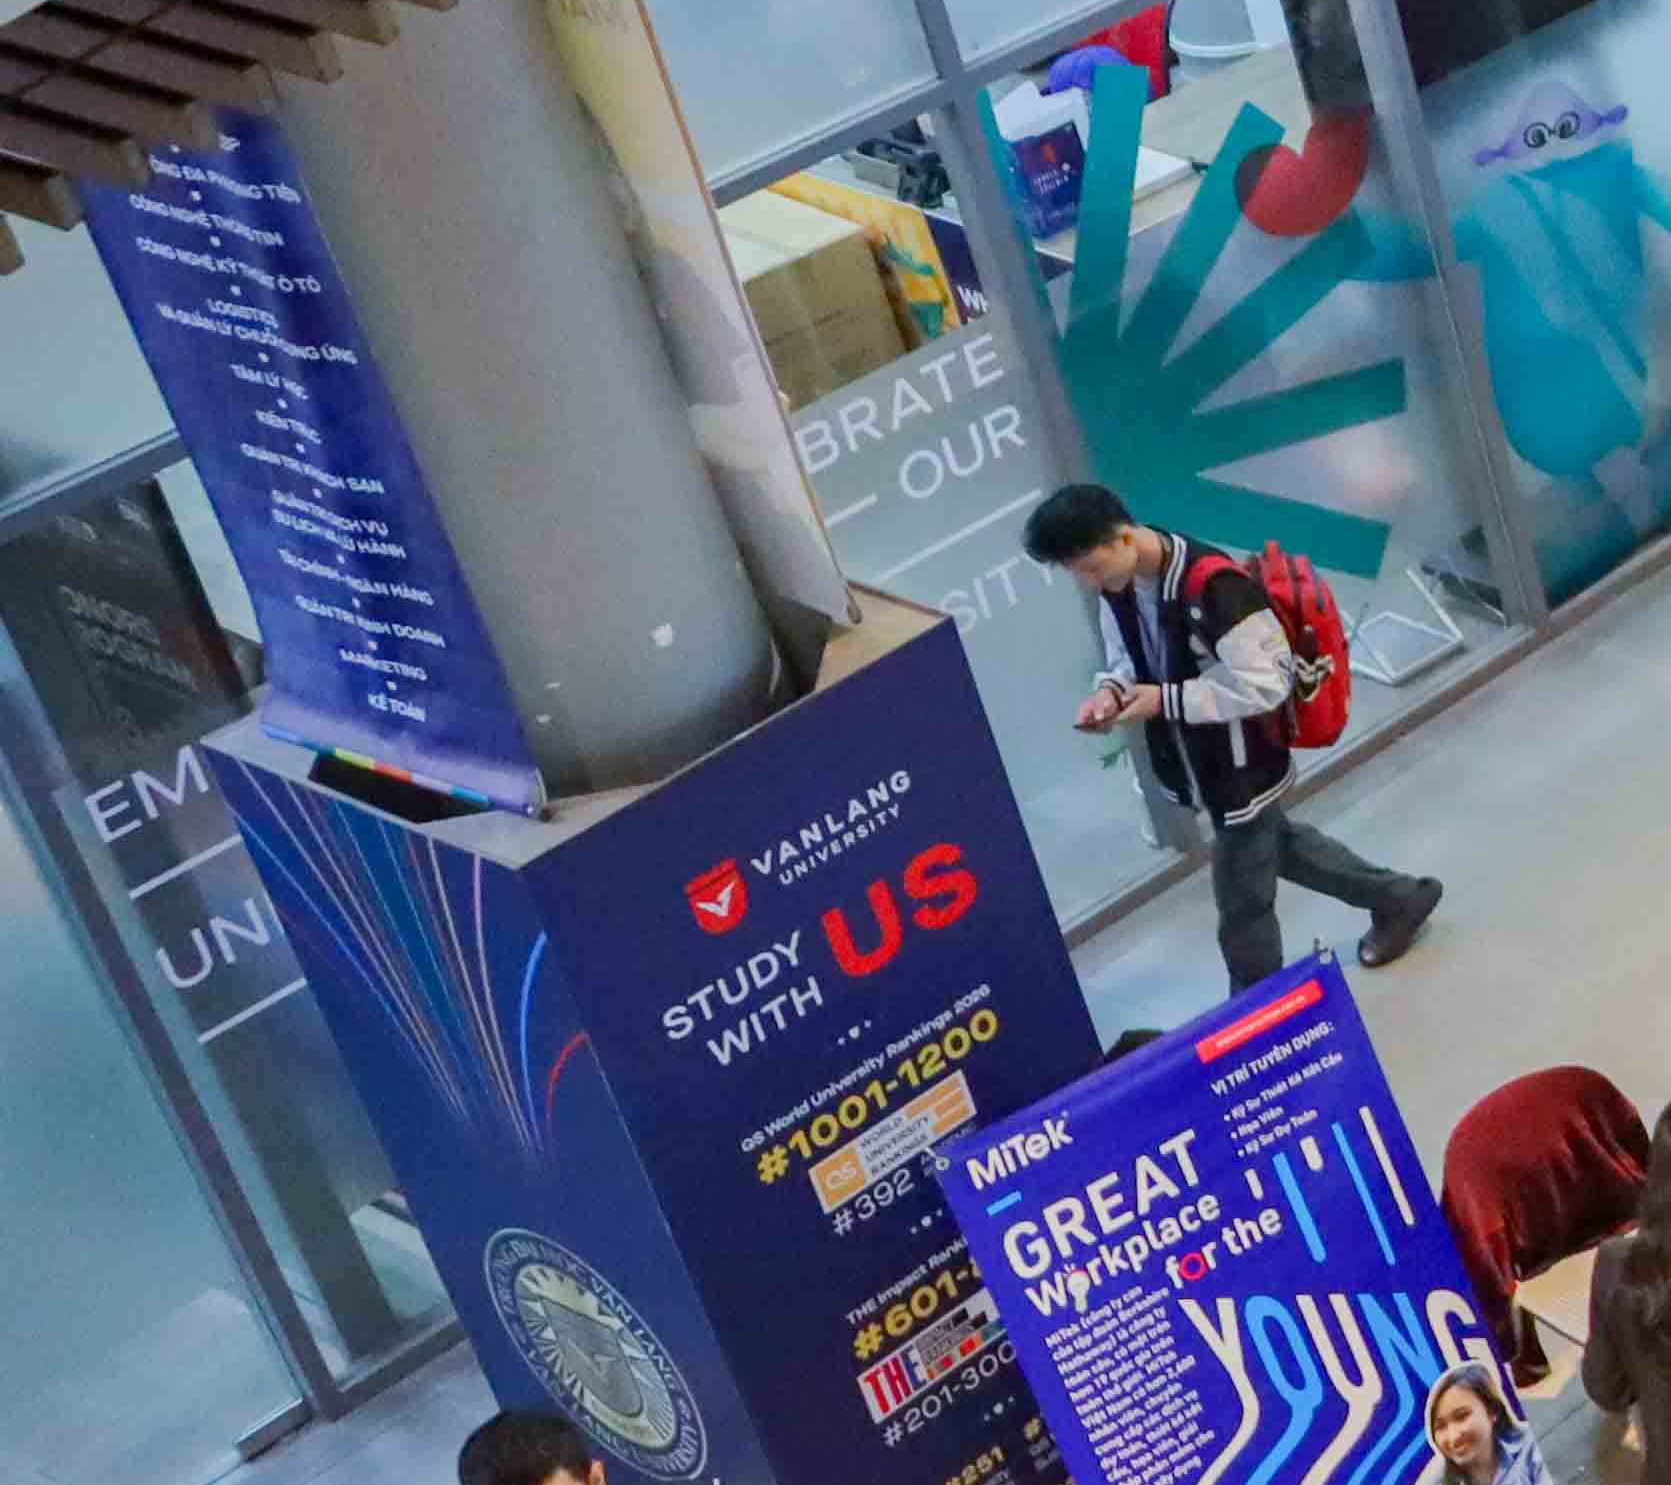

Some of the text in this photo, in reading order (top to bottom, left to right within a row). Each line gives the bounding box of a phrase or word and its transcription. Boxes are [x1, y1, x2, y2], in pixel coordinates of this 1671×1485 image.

[795, 332, 1004, 475] BRATE
[900, 404, 1025, 499] OUR
[750, 769, 911, 875] VANLANG
[778, 803, 900, 885] UNIVERSITY
[821, 842, 978, 977] US
[662, 930, 800, 1039] STUDY
[707, 976, 823, 1065] WITH
[741, 1126, 769, 1153] QS
[766, 1100, 811, 1139] World
[810, 1052, 886, 1106] University
[886, 1010, 952, 1059] Rankings
[757, 1009, 998, 1185] #1001-1200
[832, 1167, 914, 1237] #392
[965, 1116, 1074, 1191] MiTek
[1001, 1128, 1201, 1286] GREAT
[1165, 1202, 1285, 1291] for the
[845, 1299, 878, 1325] THE
[853, 1257, 982, 1361] #601-
[883, 1339, 1017, 1448] #201-300
